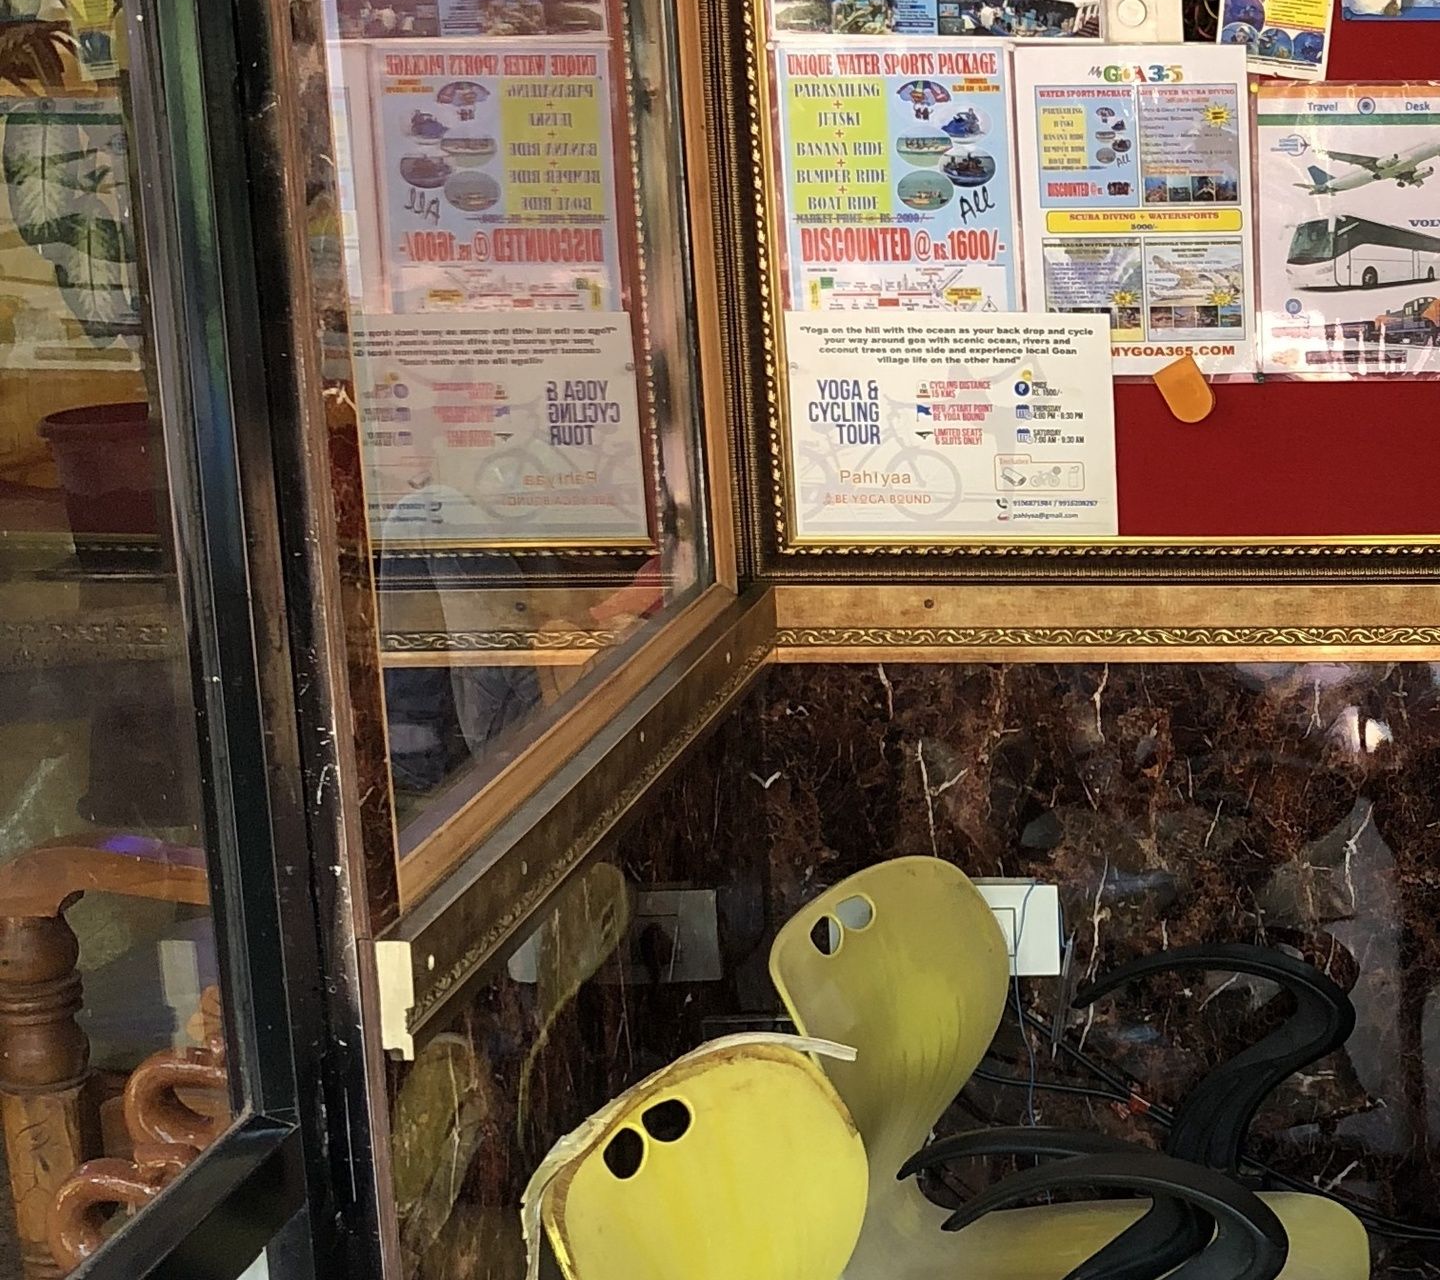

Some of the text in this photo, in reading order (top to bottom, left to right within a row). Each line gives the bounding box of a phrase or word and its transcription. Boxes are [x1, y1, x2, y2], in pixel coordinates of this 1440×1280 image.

[787, 52, 997, 78] UNIQUE WATER SPORTS PACKAGE
[794, 83, 880, 98] PARASAILING
[1039, 89, 1132, 98] WATER SPORTS PACKAGE
[1307, 101, 1431, 113] Travel Desk
[818, 111, 860, 128] JETSKI
[796, 141, 883, 157] BANANA RIDE
[796, 170, 888, 184] BUMPER RIDE
[1047, 182, 1090, 197] DISCOUNTED
[808, 196, 880, 210] BOAT RIDE
[1069, 213, 1102, 221] SCUBA
[1149, 211, 1220, 220] WATERSPORTS
[800, 227, 911, 262] DISCOUNTED
[914, 229, 933, 262] @
[865, 326, 880, 334] hill
[883, 326, 905, 334] with
[907, 326, 923, 334] the
[972, 328, 994, 336] your
[1023, 327, 1045, 336] drop
[1068, 328, 1094, 337] cycle
[824, 337, 846, 345] your
[848, 337, 868, 345] way
[871, 336, 905, 344] around
[907, 337, 926, 345] goa
[819, 346, 859, 354] coconut
[861, 346, 887, 354] trees
[926, 346, 946, 354] side
[948, 346, 966, 354] and
[969, 347, 1023, 355] experience
[1052, 347, 1077, 355] Goan
[877, 356, 910, 365] village
[913, 356, 928, 364] life
[945, 356, 963, 364] the
[964, 356, 990, 364] other
[816, 379, 879, 401] YOGA &
[808, 401, 880, 423] CYCLING
[836, 424, 881, 445] TOUR
[835, 494, 932, 504] BE YOGA BOUND
